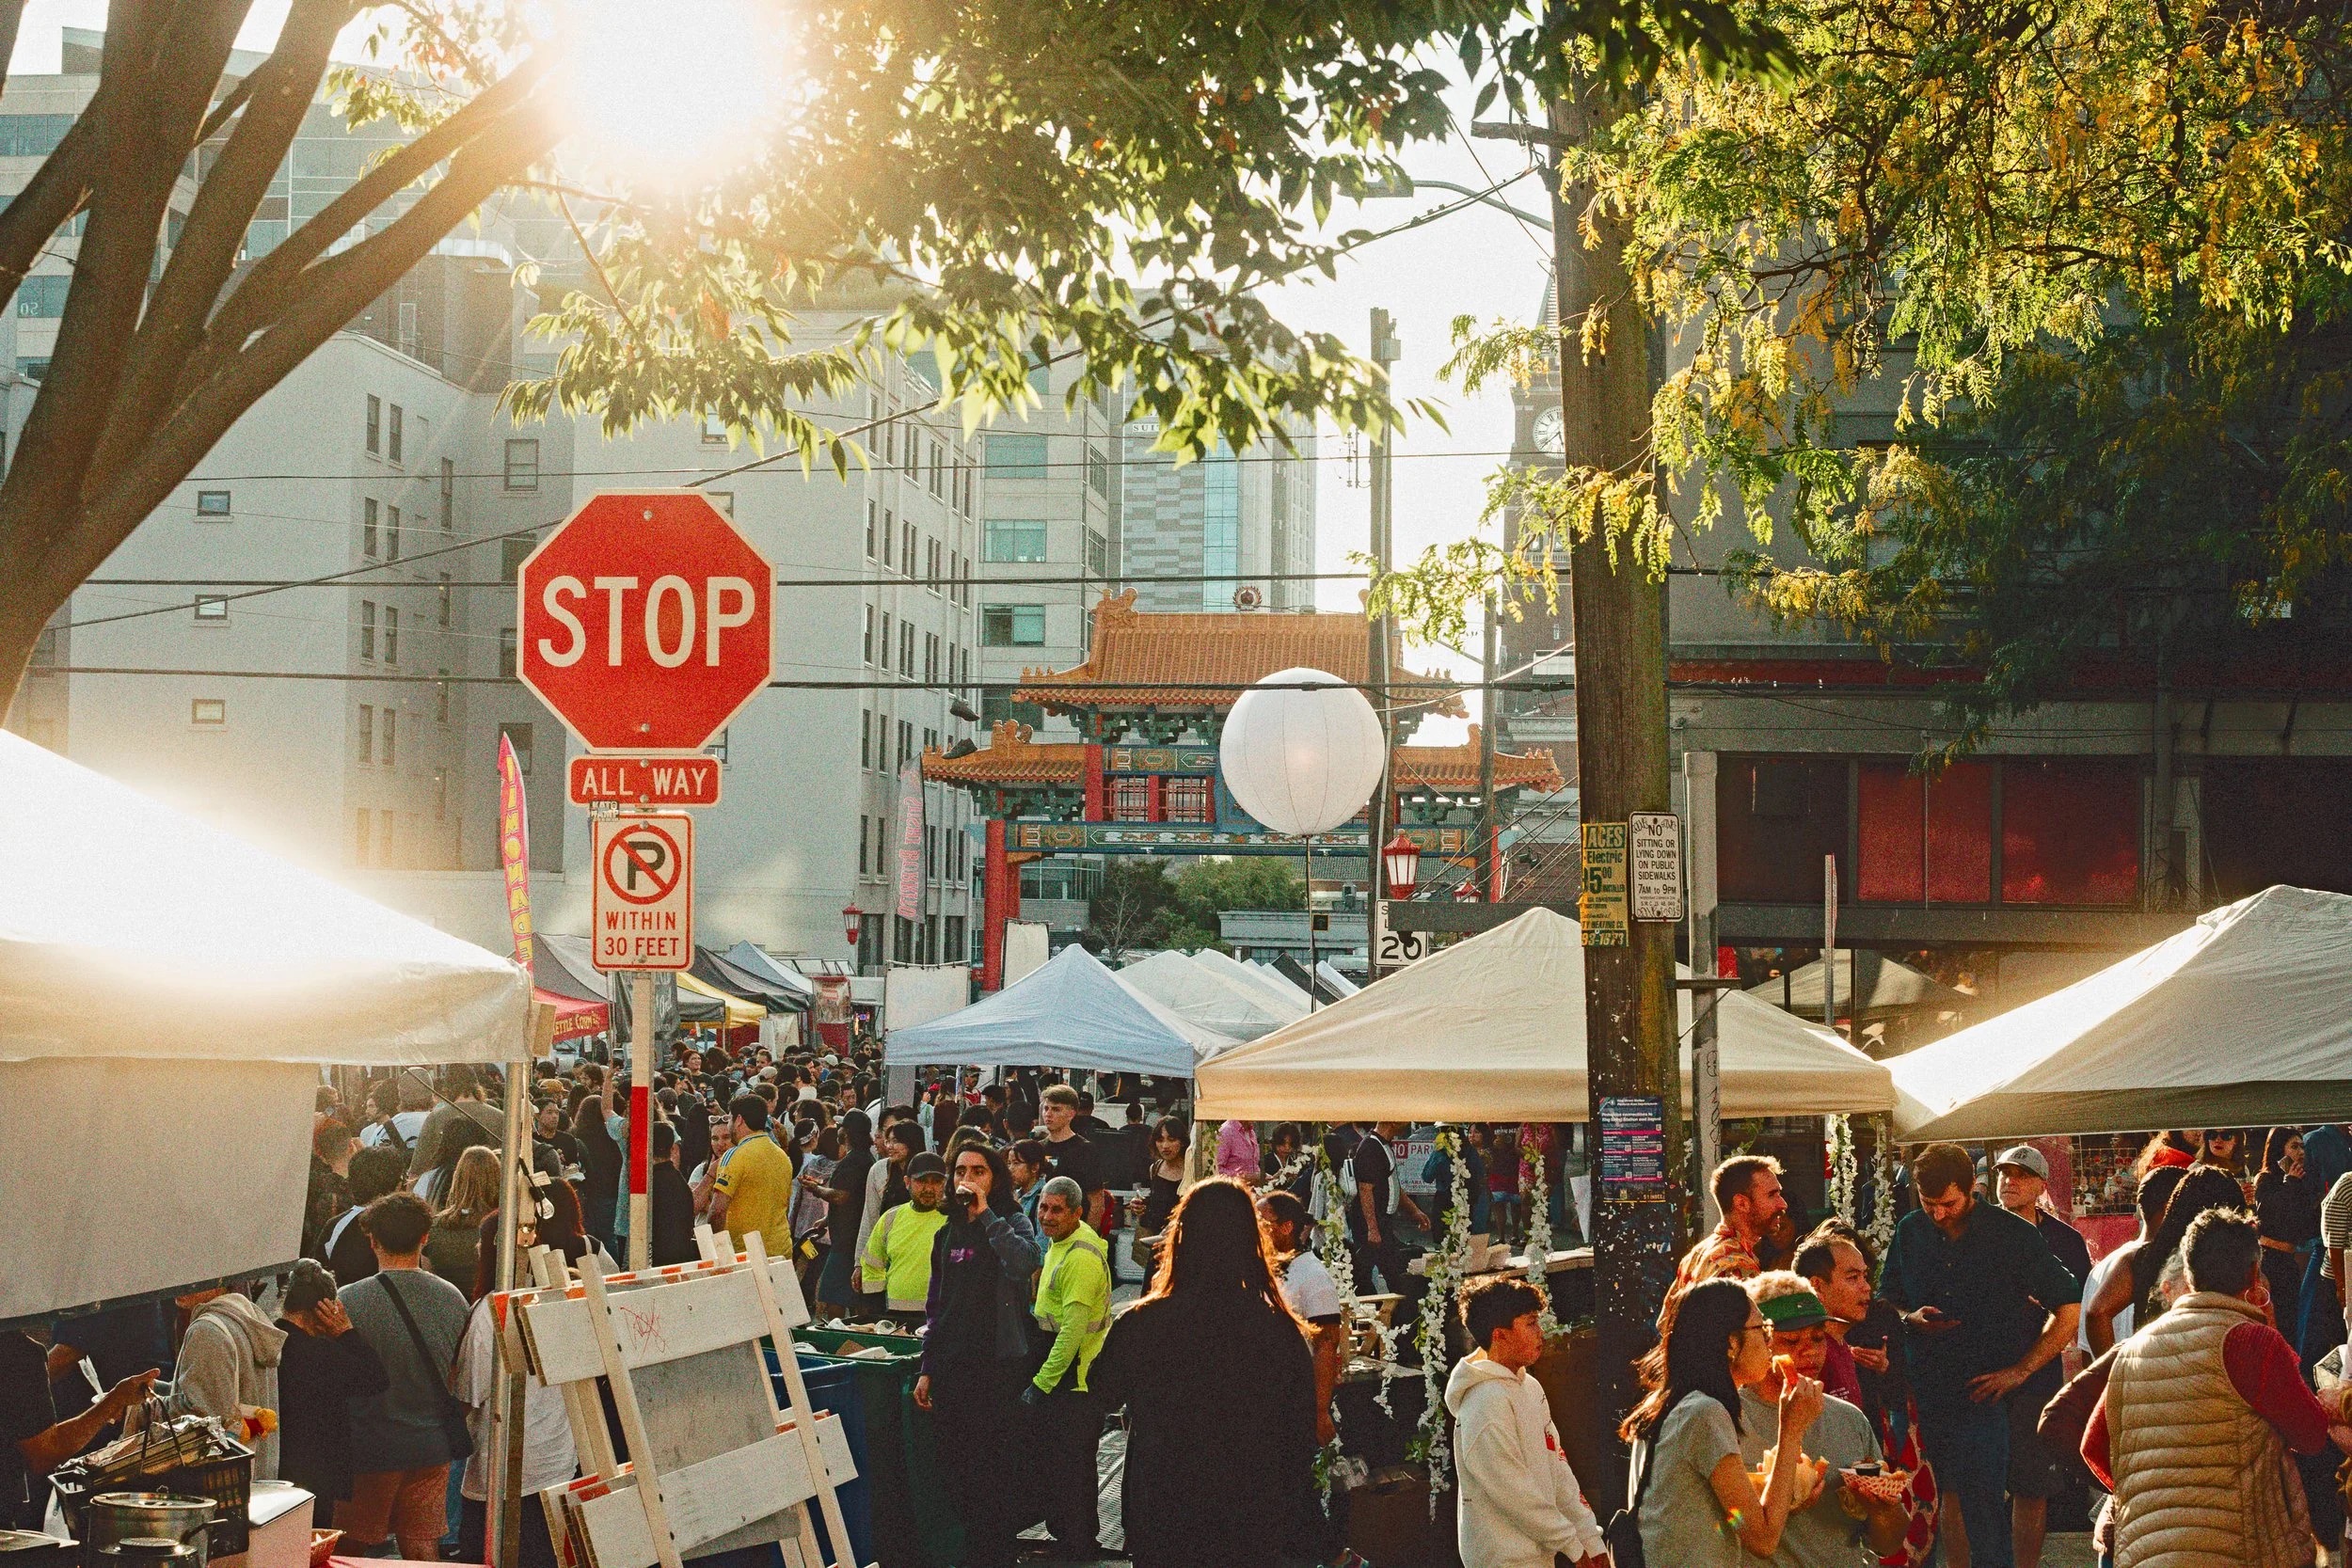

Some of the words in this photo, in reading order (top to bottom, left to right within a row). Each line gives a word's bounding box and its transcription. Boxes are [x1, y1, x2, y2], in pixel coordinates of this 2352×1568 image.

[537, 575, 755, 668] STOP
[581, 768, 633, 796] ALL
[652, 768, 709, 796] WAY
[1648, 824, 1662, 836] NO
[1636, 838, 1663, 847] SITTING
[1665, 838, 1676, 847] OR
[1587, 851, 1623, 864] Electric
[1636, 849, 1655, 859] LYING
[1657, 849, 1677, 859] DOWN
[1638, 861, 1648, 869] ON
[1651, 861, 1675, 869] PUBLIC
[1638, 871, 1677, 880] SIDEWALKS
[1638, 883, 1651, 894] 7AM
[1661, 883, 1677, 894] 9PM
[605, 911, 676, 931] WITHIN
[604, 937, 628, 958] 30
[635, 937, 678, 958] FEET
[1380, 936, 1422, 960] 20
[554, 1017, 573, 1036] ETTLE
[1411, 1145, 1432, 1154] PAR
